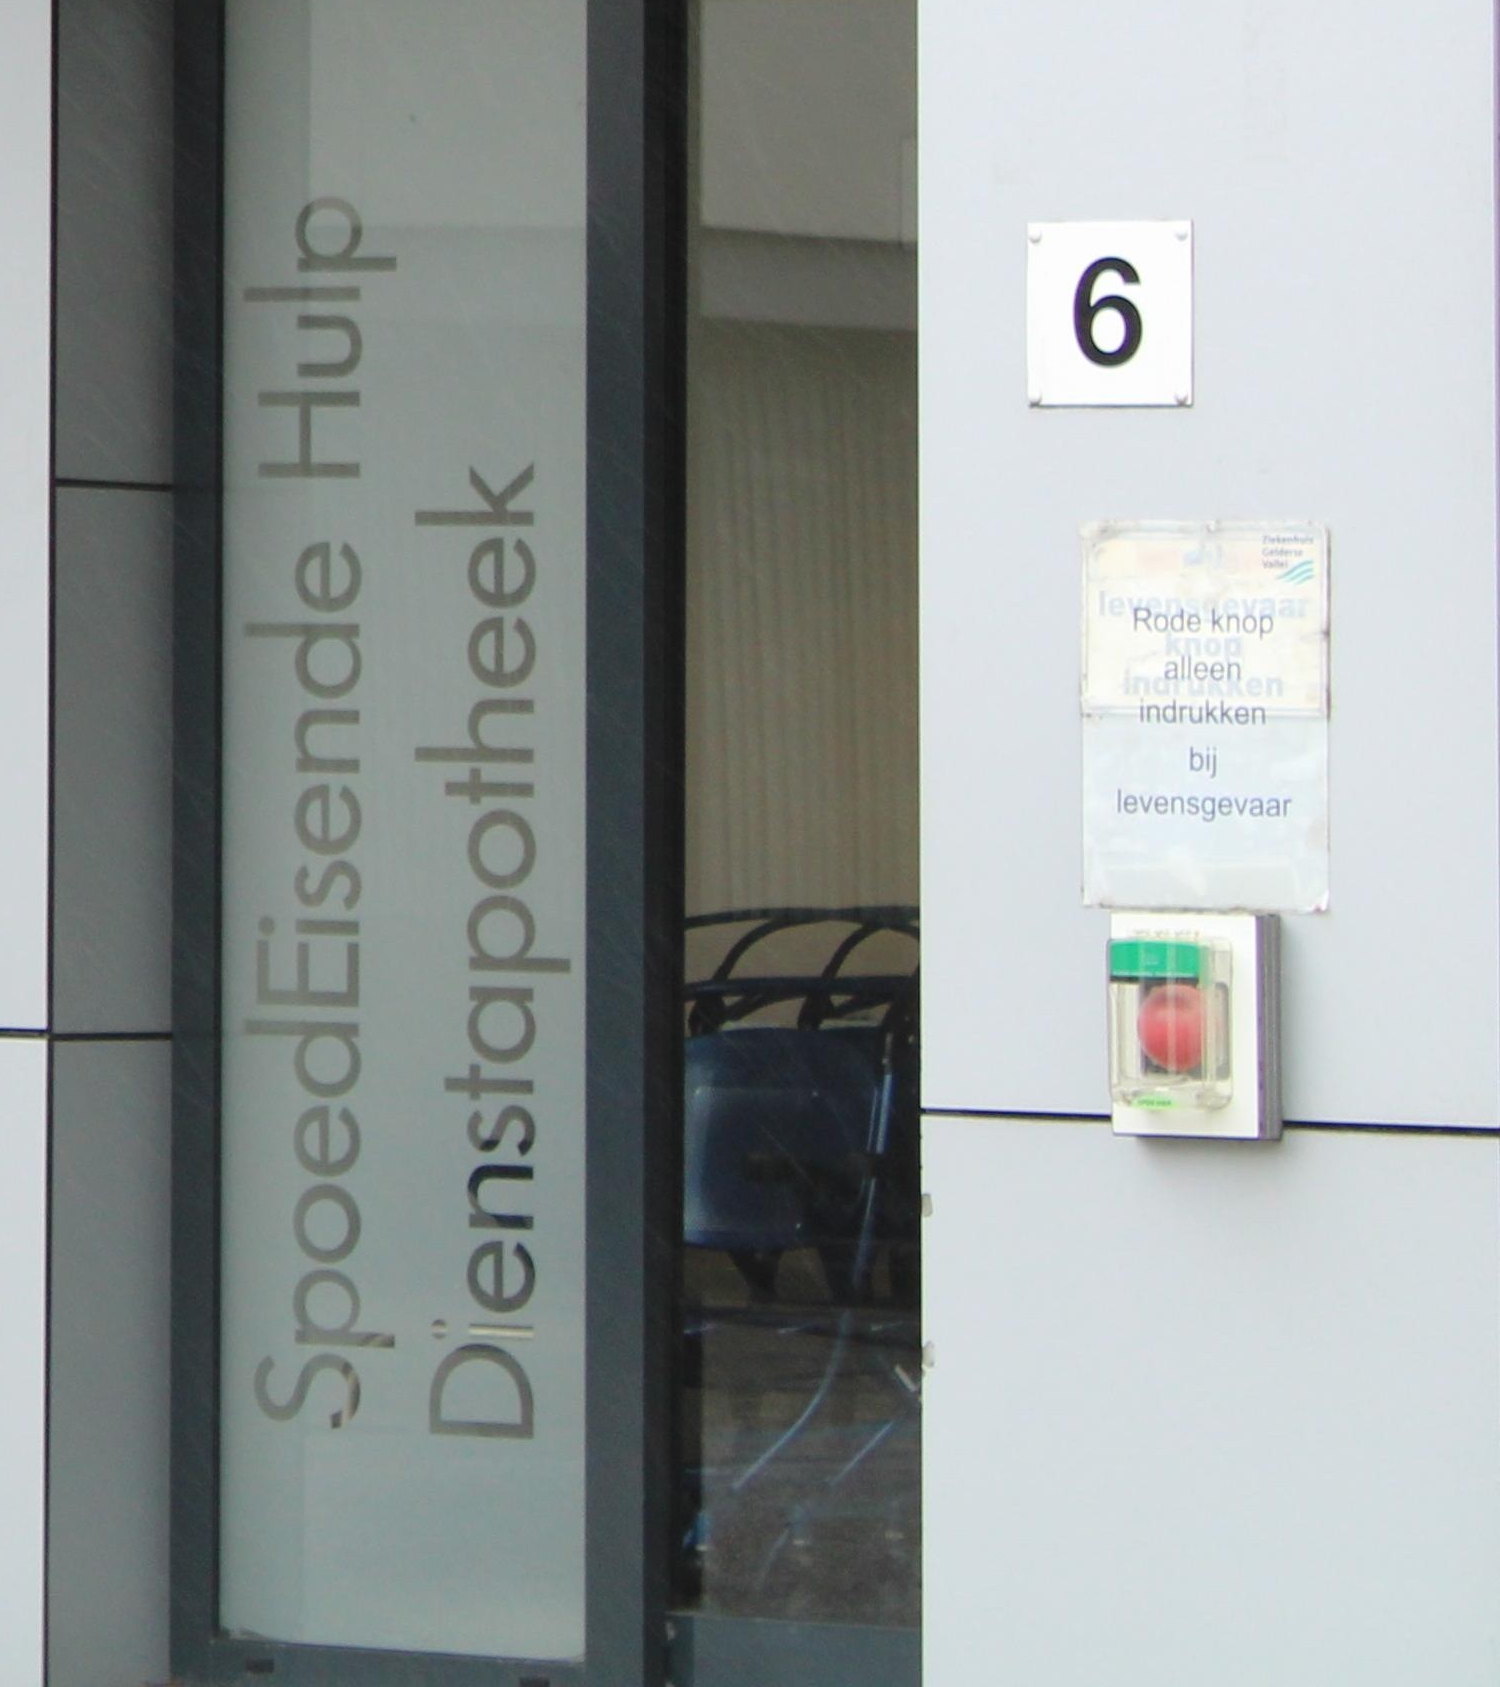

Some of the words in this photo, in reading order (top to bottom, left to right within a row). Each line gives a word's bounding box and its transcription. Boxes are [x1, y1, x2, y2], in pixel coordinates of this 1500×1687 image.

[1073, 256, 1143, 368] 6
[243, 196, 398, 480] Hulp
[1132, 607, 1202, 634] Rode
[1211, 607, 1274, 640] knop
[1163, 654, 1242, 681] alleen
[1138, 698, 1267, 726] indrukken
[1188, 745, 1218, 780] bij
[1116, 788, 1293, 823] levensgevaar
[415, 461, 572, 1442] Dienstapotheek
[244, 539, 397, 1431] SpoedEisende
